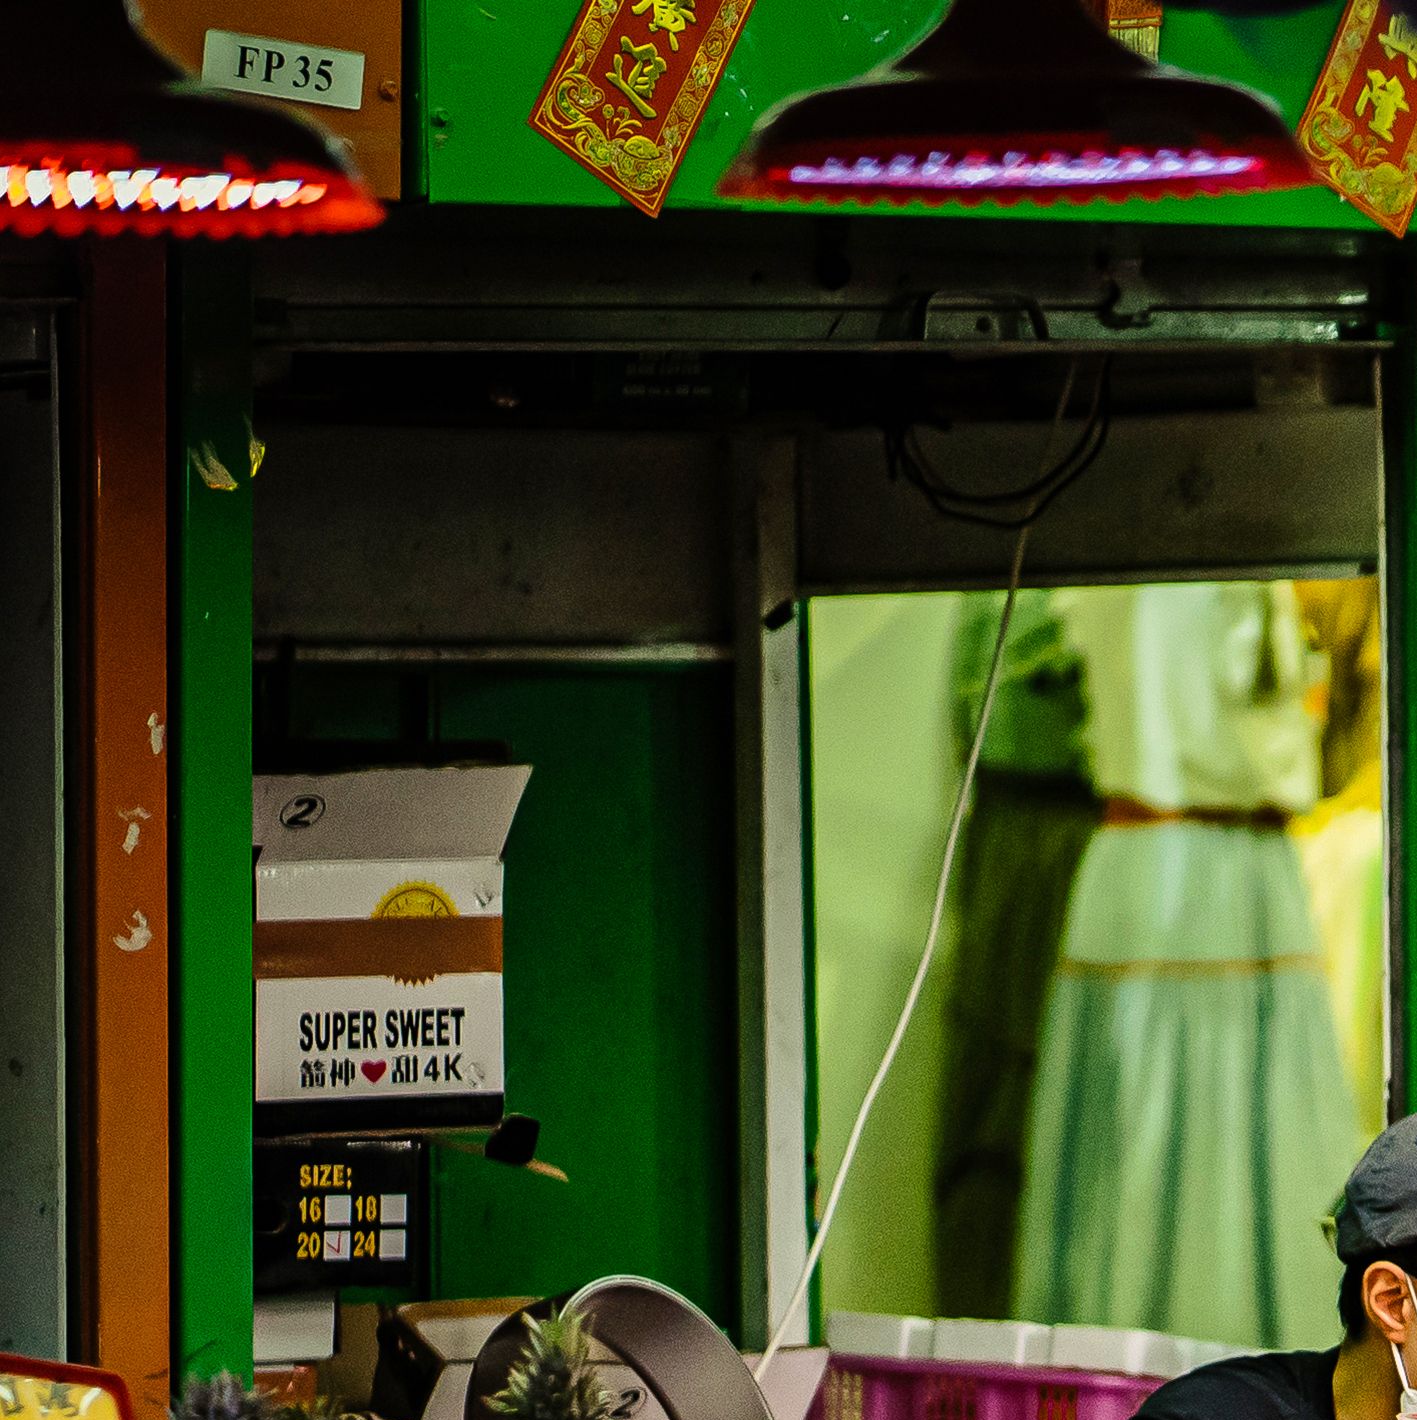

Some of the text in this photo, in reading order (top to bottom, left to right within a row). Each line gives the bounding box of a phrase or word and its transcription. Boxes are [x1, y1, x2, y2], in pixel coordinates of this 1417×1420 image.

[234, 44, 334, 91] FP 35
[299, 1006, 466, 1051] SUPER SWEET
[299, 1163, 352, 1190] SIZE:
[299, 1194, 377, 1224] 16 18
[296, 1230, 376, 1259] 20 24
